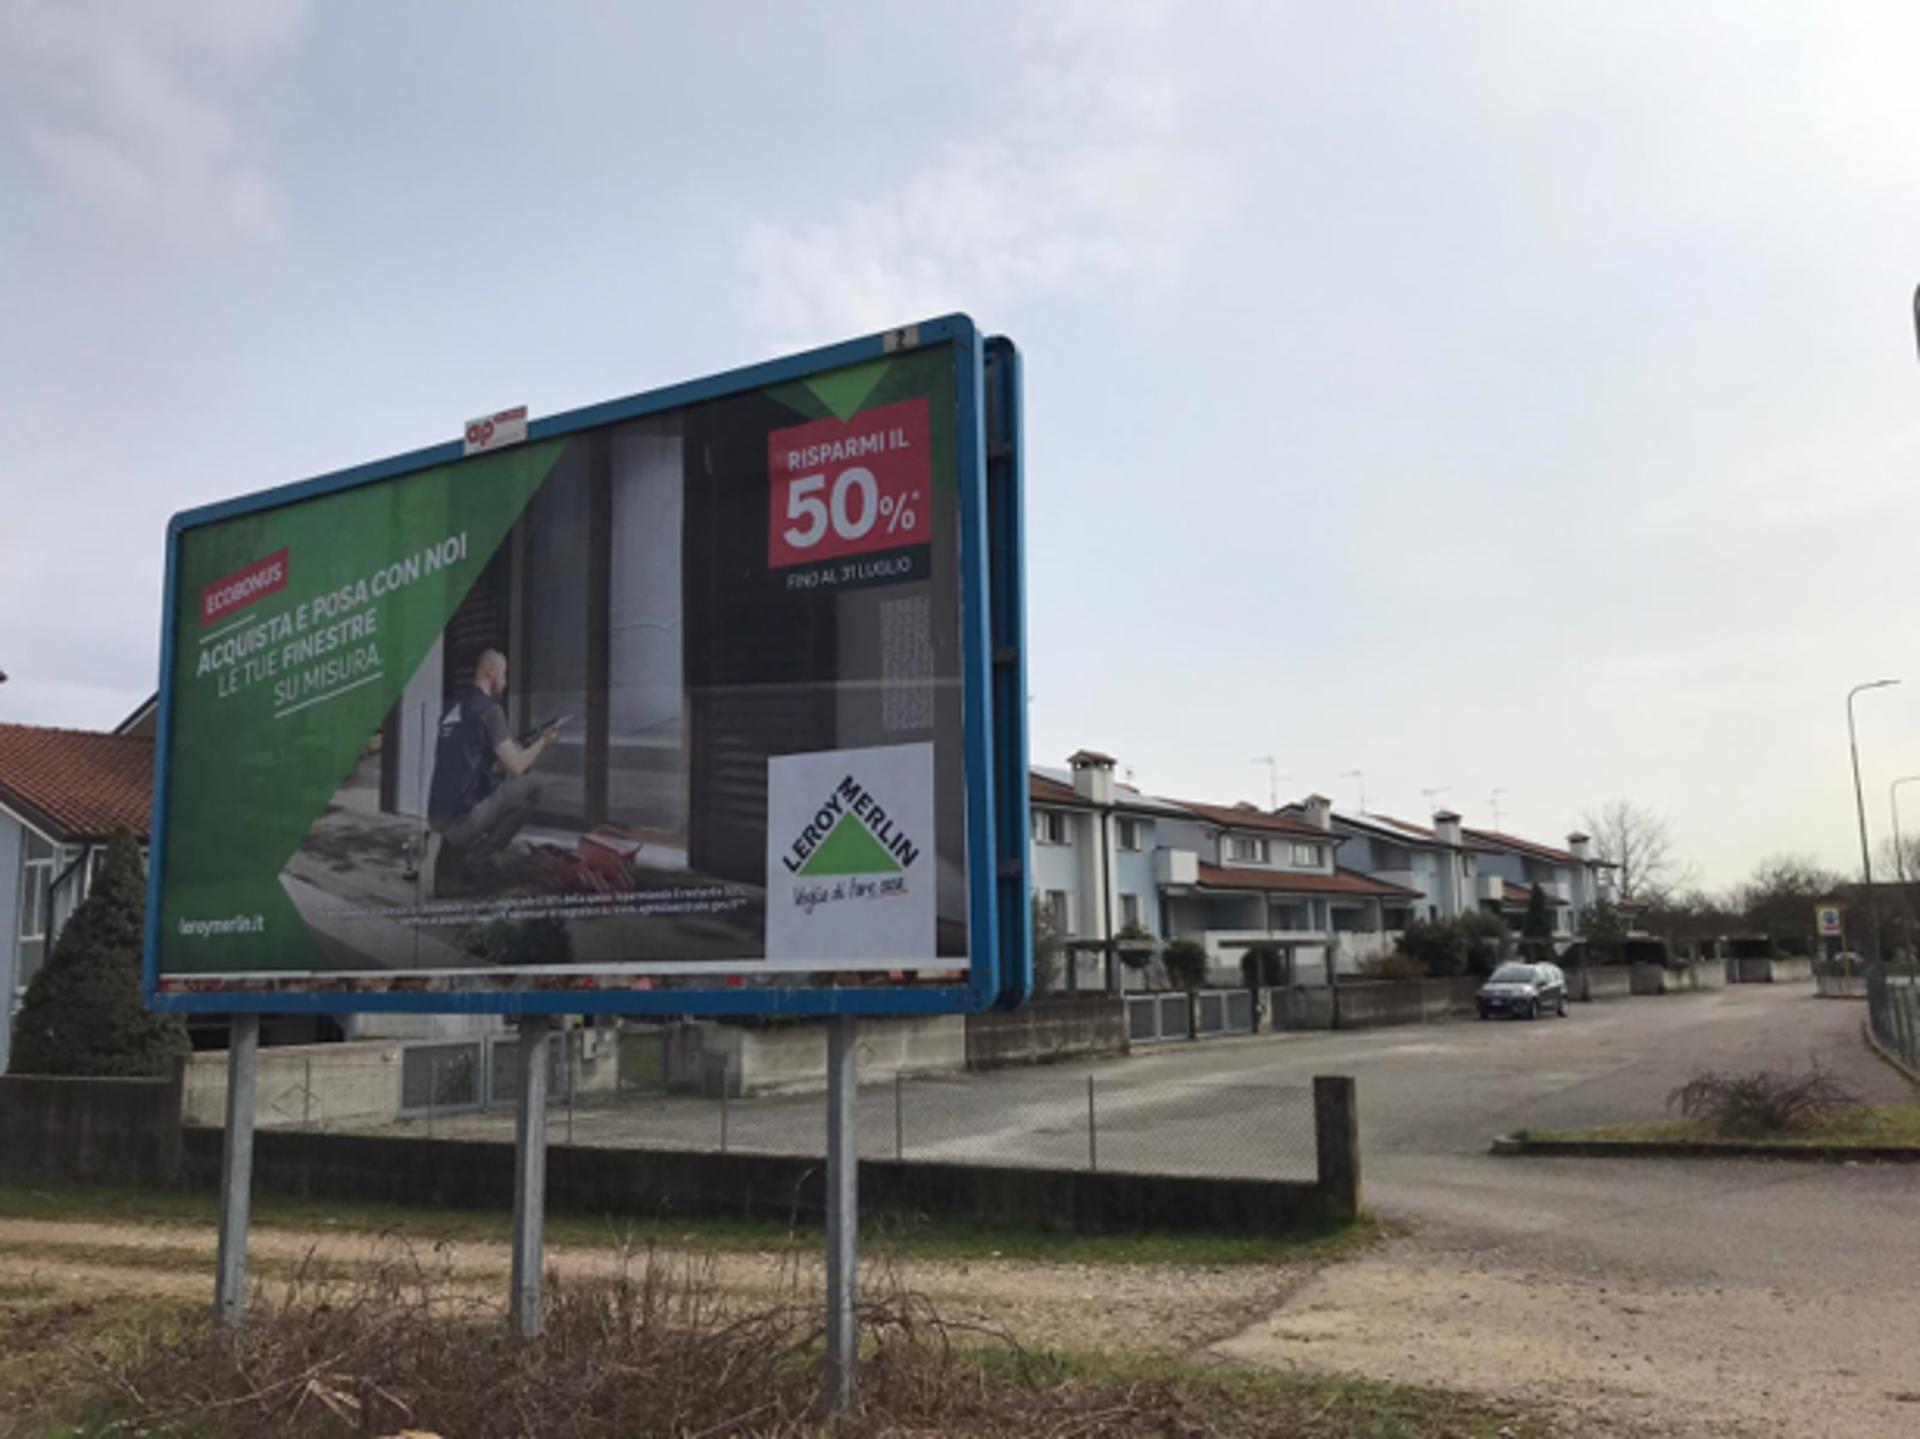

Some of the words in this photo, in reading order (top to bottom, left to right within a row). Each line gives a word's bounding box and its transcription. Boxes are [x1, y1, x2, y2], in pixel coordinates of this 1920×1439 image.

[787, 433, 884, 471] RISPARMI
[889, 427, 909, 448] IL
[204, 561, 283, 615] ECOBONUS
[785, 570, 819, 591] FINO
[821, 567, 838, 585] AL
[841, 563, 856, 582] 31
[858, 554, 913, 580] LUGLIO
[196, 612, 293, 678] ACQUISTA
[295, 604, 308, 632] E
[311, 579, 369, 624] POSA
[371, 554, 420, 598] CON
[423, 532, 468, 575] NOI
[217, 666, 239, 698] LE
[241, 652, 278, 686] TUE
[281, 607, 379, 669] FINESTRE
[273, 676, 300, 706] SU
[302, 642, 381, 694] MISURA
[782, 794, 844, 873] LEROY
[836, 773, 920, 869] MERLIN
